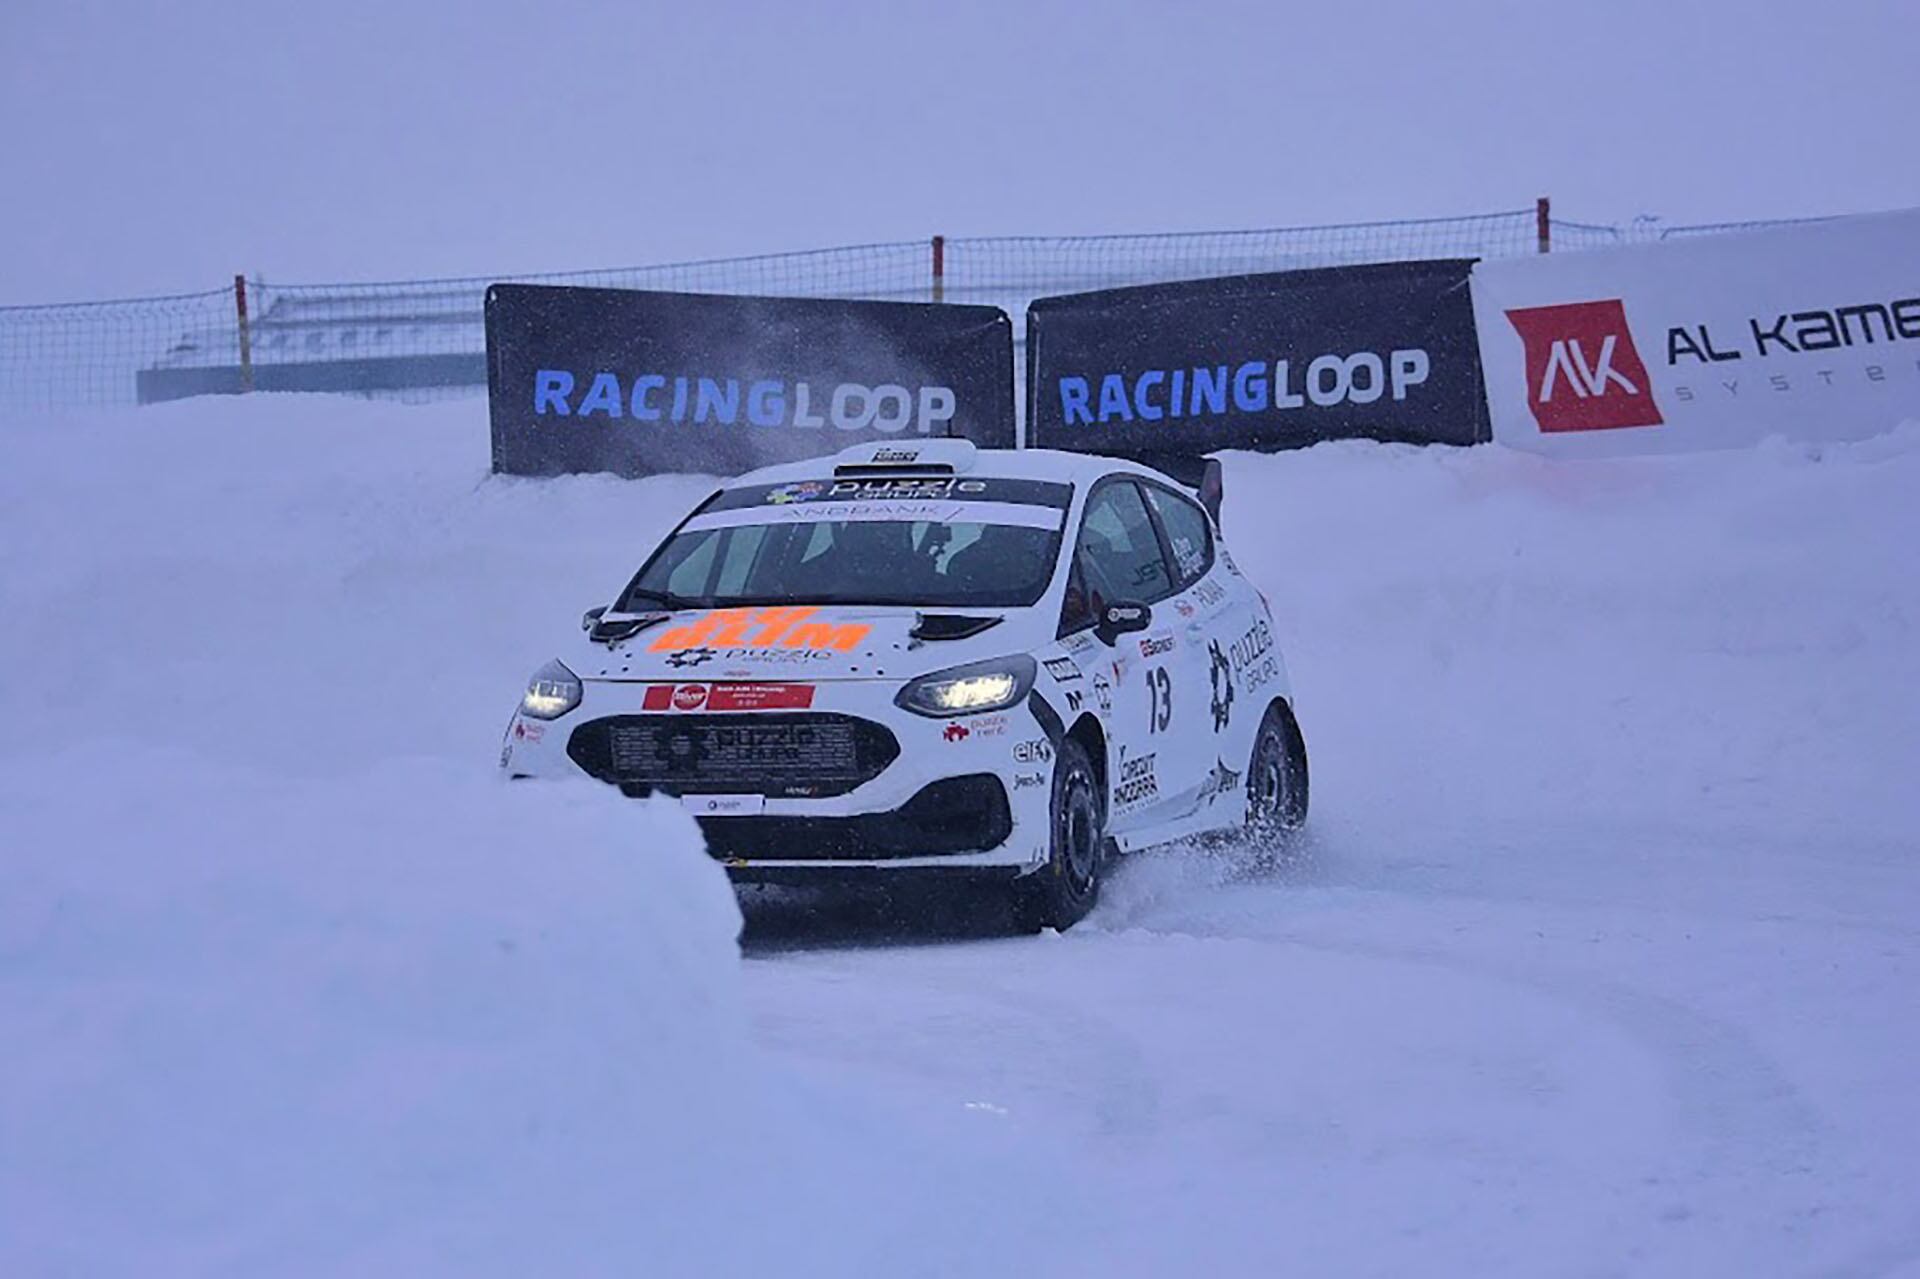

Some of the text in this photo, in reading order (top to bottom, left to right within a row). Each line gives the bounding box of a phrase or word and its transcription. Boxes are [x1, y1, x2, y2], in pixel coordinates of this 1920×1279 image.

[1667, 324, 1741, 365] AL
[533, 369, 957, 433] RACINGLOOP
[1059, 348, 1430, 426] RACINGLOOP
[783, 504, 938, 521] ANDBANK
[827, 477, 987, 496] puzzle
[1146, 665, 1172, 735] 13
